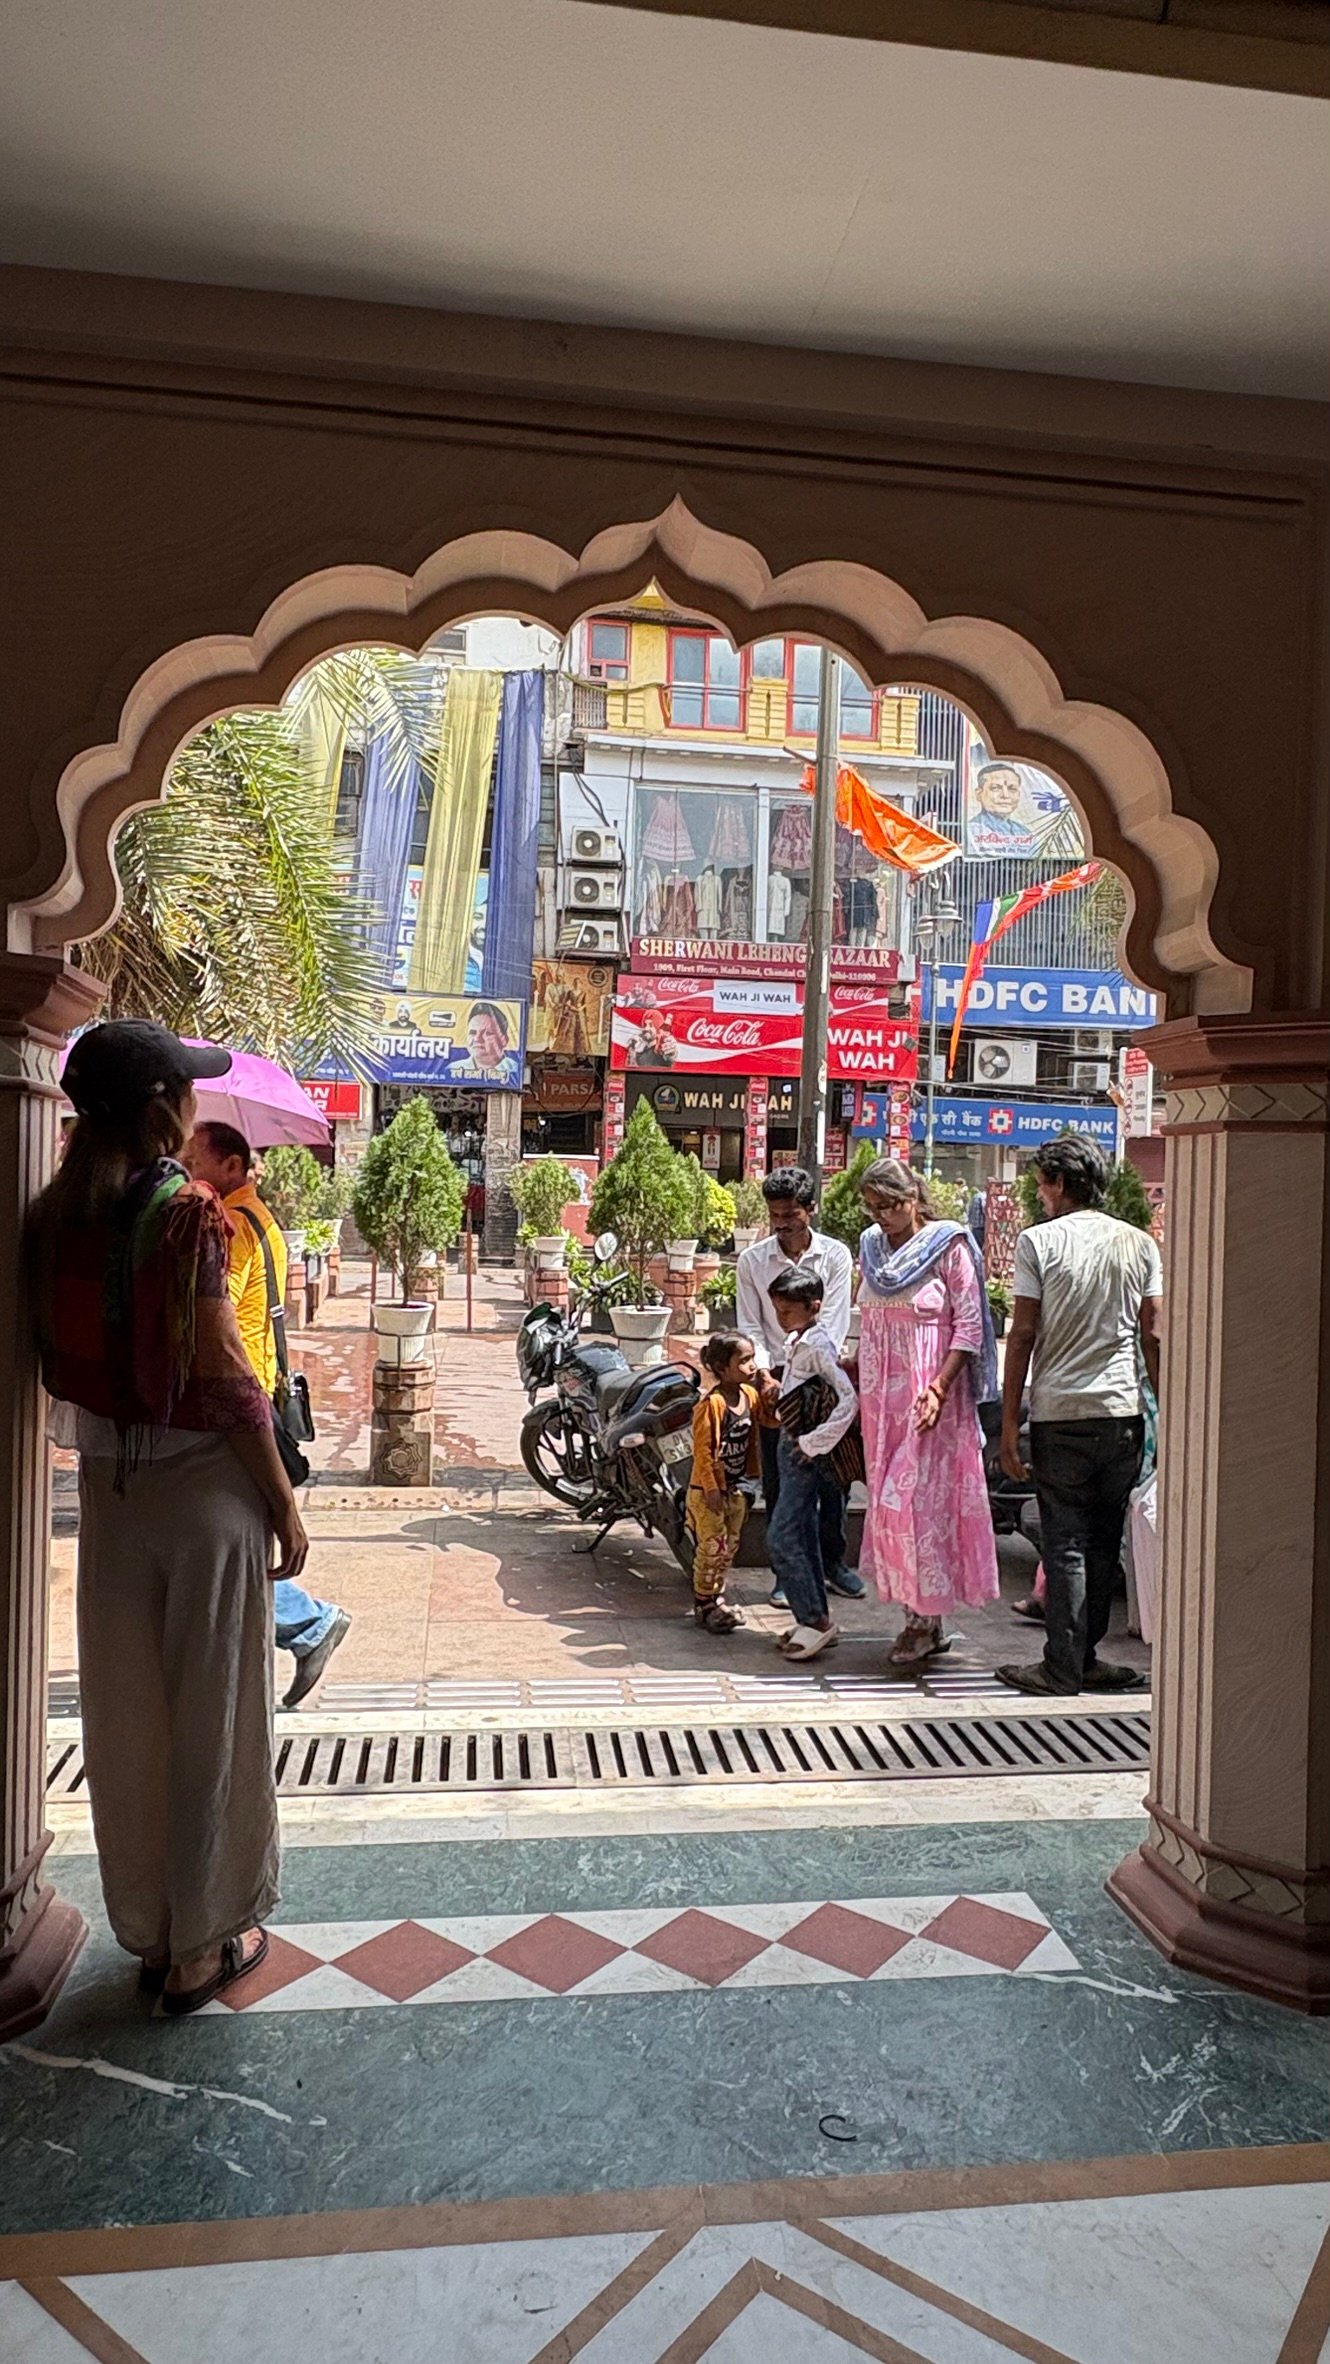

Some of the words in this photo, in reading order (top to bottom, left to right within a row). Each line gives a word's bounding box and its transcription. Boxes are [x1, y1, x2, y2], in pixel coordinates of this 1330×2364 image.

[639, 938, 734, 961] SHERWANI
[736, 943, 807, 964] LEHENG
[719, 991, 748, 1001] WAH
[750, 993, 760, 1002] JI
[763, 993, 791, 1003] WAH
[936, 979, 1048, 1012] HDFC
[827, 1028, 883, 1048] WAH
[838, 1051, 895, 1070] WAH
[684, 1092, 723, 1109] WAH
[768, 1096, 793, 1111] AH
[1017, 1116, 1063, 1131] HDFC
[1068, 1119, 1115, 1135] BANK
